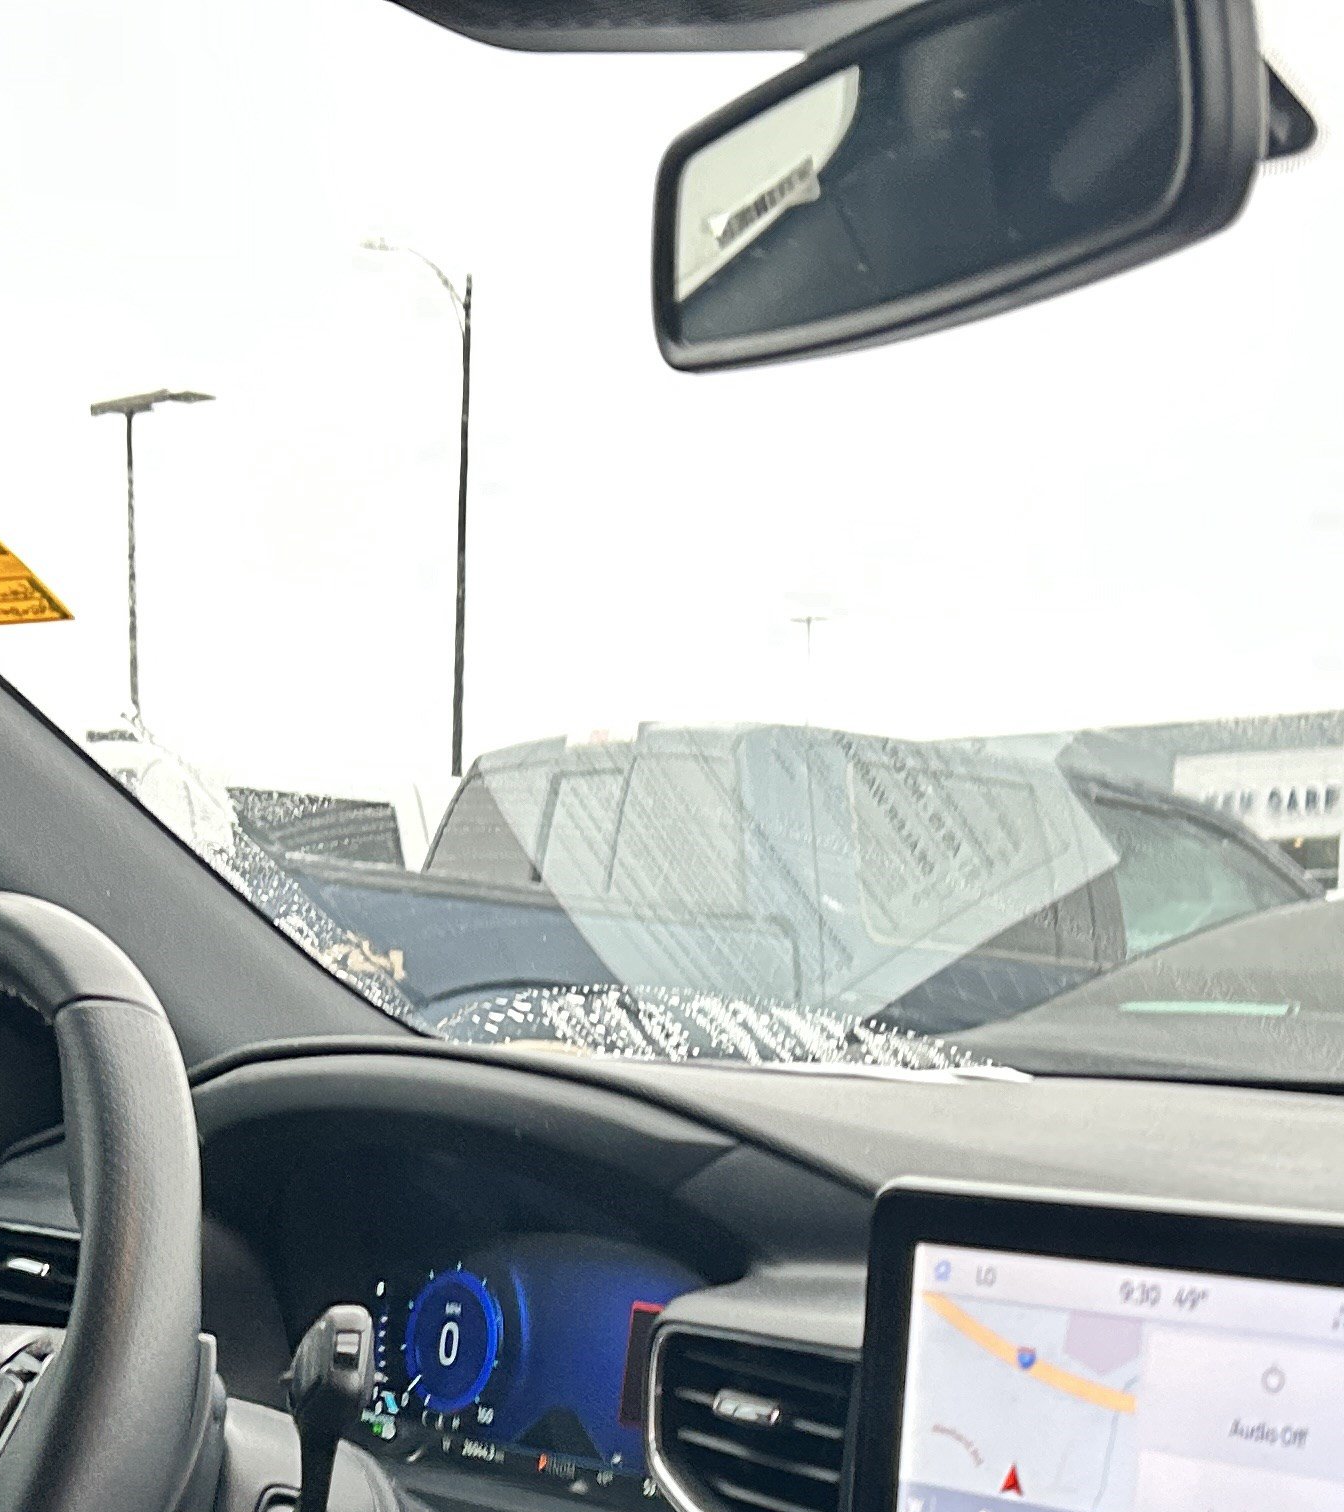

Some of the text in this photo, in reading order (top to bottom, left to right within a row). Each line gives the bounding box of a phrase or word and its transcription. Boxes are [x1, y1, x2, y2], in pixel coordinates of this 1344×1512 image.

[438, 1320, 460, 1367] 0
[1228, 1418, 1310, 1448] Audio Off
